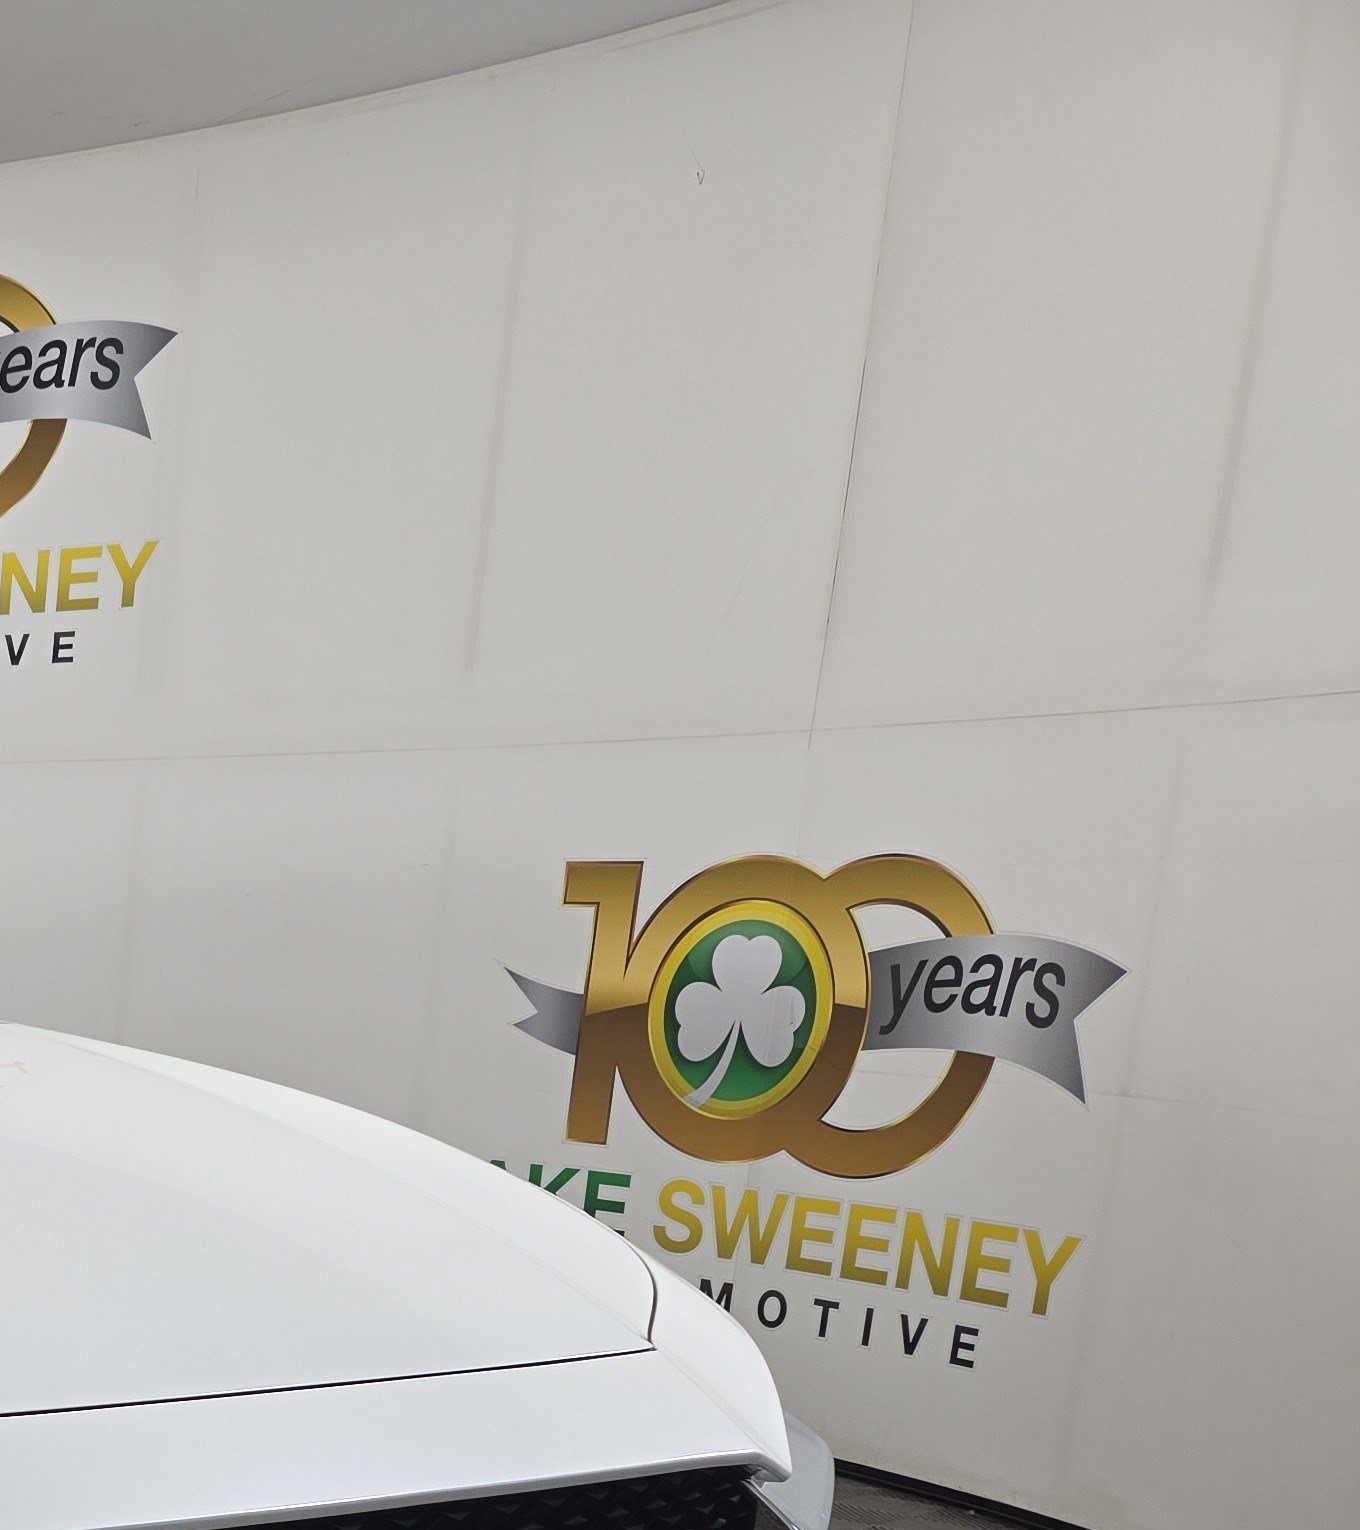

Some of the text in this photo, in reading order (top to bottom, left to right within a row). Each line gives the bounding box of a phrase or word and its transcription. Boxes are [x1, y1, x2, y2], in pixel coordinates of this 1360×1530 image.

[564, 853, 1066, 1179] 100 years
[652, 1179, 1082, 1317] SWEENEY
[698, 1278, 980, 1369] MOTIVE
